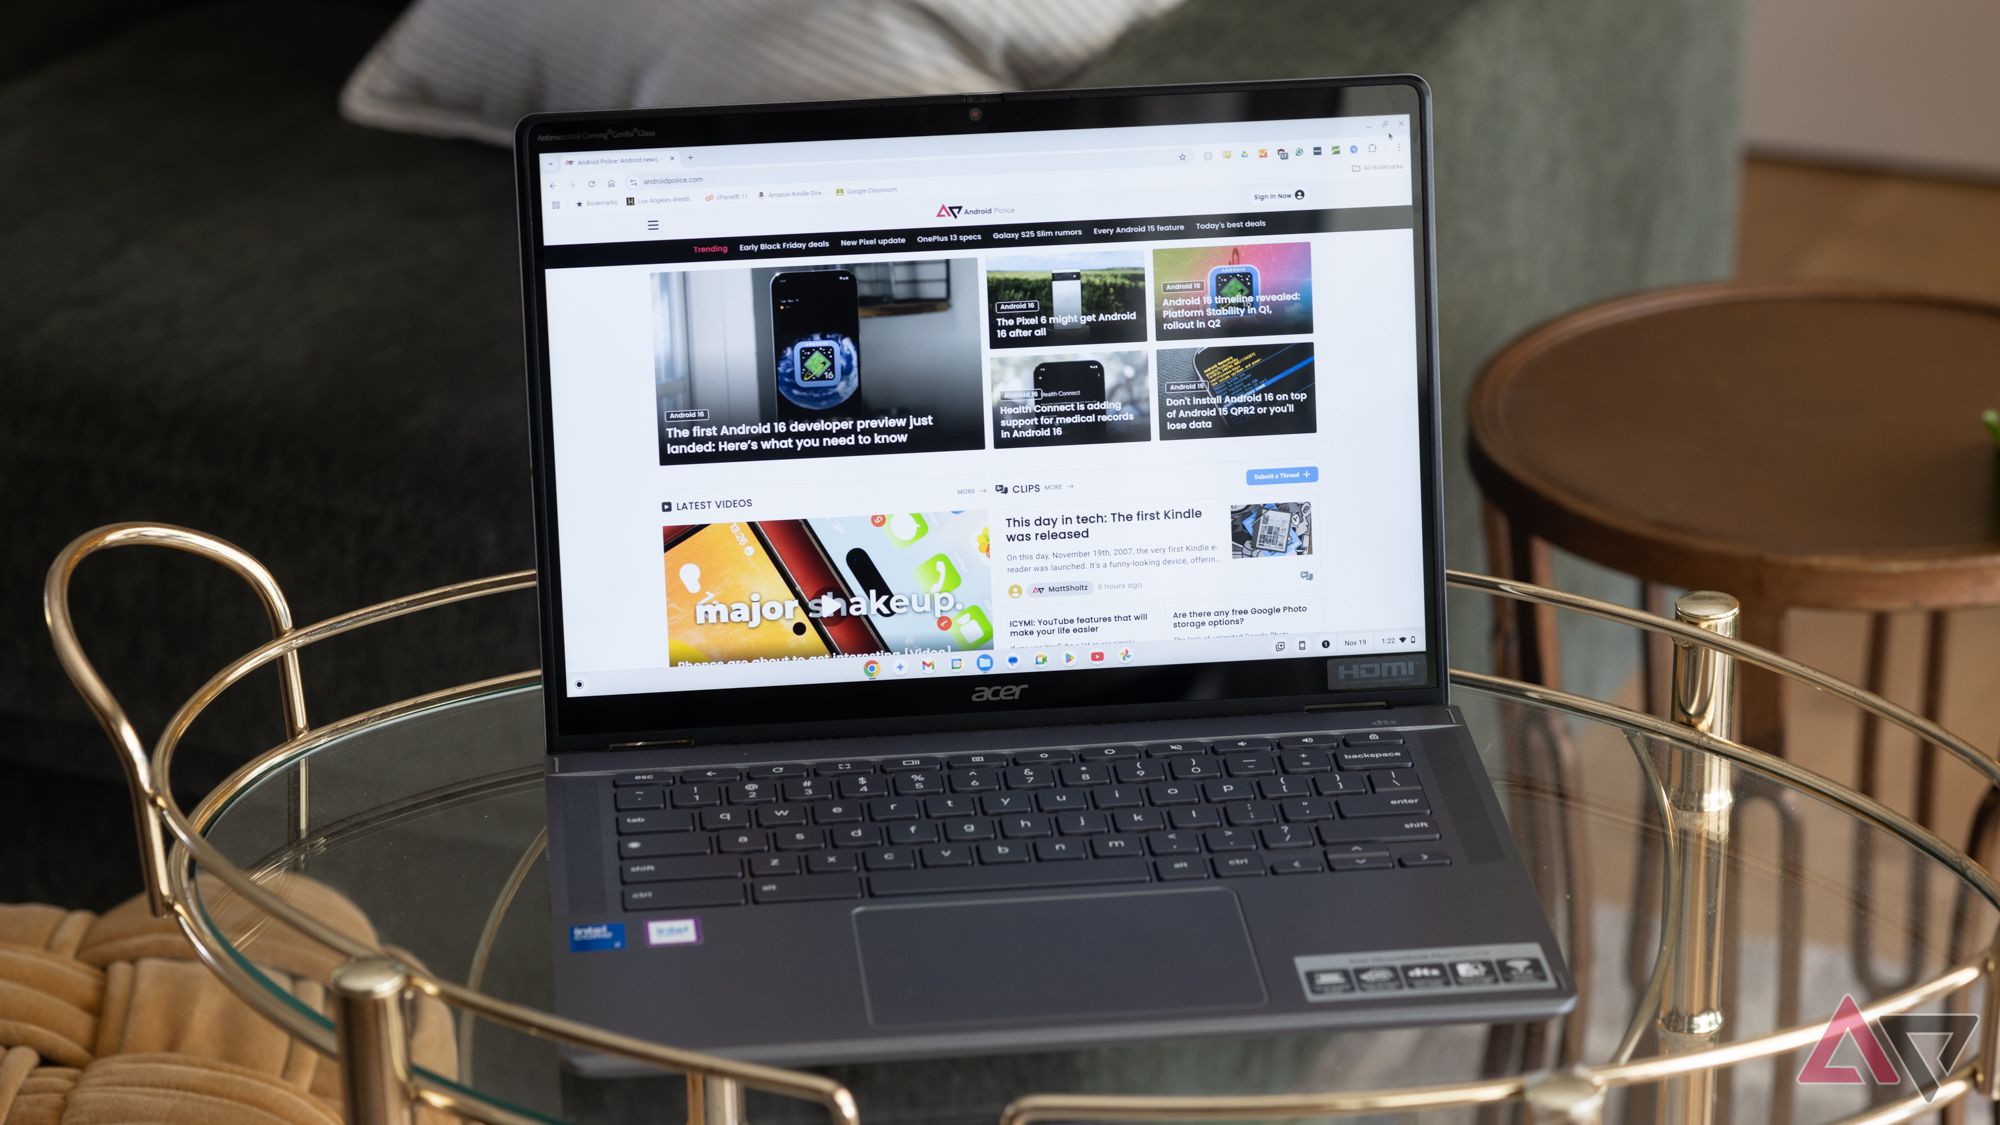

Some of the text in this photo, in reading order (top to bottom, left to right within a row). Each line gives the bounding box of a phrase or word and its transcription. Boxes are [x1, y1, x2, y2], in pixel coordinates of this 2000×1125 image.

[644, 176, 703, 185] androidpolice.com
[1254, 193, 1268, 201] Sign
[1094, 222, 1184, 236] Every Android 15 feature
[1196, 221, 1225, 230] Today's
[1245, 220, 1266, 228] deals
[917, 235, 948, 243] OnePlus
[959, 233, 982, 242] specs
[993, 231, 1018, 240] Galaxy
[739, 240, 829, 252] Early Black Friday deals
[878, 237, 906, 247] update
[694, 244, 728, 254] Trending
[1163, 293, 1300, 306] Android 16 timeline revealed:
[1000, 302, 1027, 310] Android
[1163, 305, 1272, 318] Platform Stability in Q1,
[997, 311, 1136, 326] The Pixel 6 might get Android
[1163, 319, 1221, 330] rollout in Q2
[997, 327, 1046, 338] 16 after all
[1166, 391, 1307, 407] Don't install Android 16 on top
[1000, 400, 1121, 415] Health Connect is adding
[1166, 403, 1294, 418] of Android 15 QPR2 or you'll
[1001, 412, 1134, 427] support for medical records
[1167, 419, 1212, 430] lose data
[666, 415, 933, 439] The first Android 16 developer preview just
[1001, 427, 1062, 438] in Android 16
[667, 432, 907, 454] landed: Here's what you need to know
[1013, 484, 1040, 494] CLIPS
[676, 499, 752, 510] LATEST VIDEOS
[1006, 508, 1202, 528] This day in tech: The first Kindle
[1007, 528, 1089, 542] was released
[1035, 552, 1050, 561] day,
[1052, 550, 1090, 558] November
[1093, 549, 1111, 558] 19th,
[1114, 548, 1133, 557] 2007,
[1136, 547, 1148, 555] the
[1150, 547, 1165, 556] very
[1167, 545, 1183, 553] first
[1186, 544, 1209, 552] Kindle
[1049, 584, 1088, 593] MattSholtz
[695, 592, 798, 628] major
[1173, 605, 1307, 619] Are there any free Google Photo
[1010, 613, 1148, 628] ICYMI: YouTube features that will
[1173, 617, 1244, 629] storage options?
[1010, 626, 1098, 638] make your life easier
[1345, 639, 1357, 647] Nov
[1382, 637, 1395, 645] 1:22
[1338, 662, 1415, 679] HDMI
[971, 684, 1028, 702] acer
[1345, 751, 1401, 759] backspace
